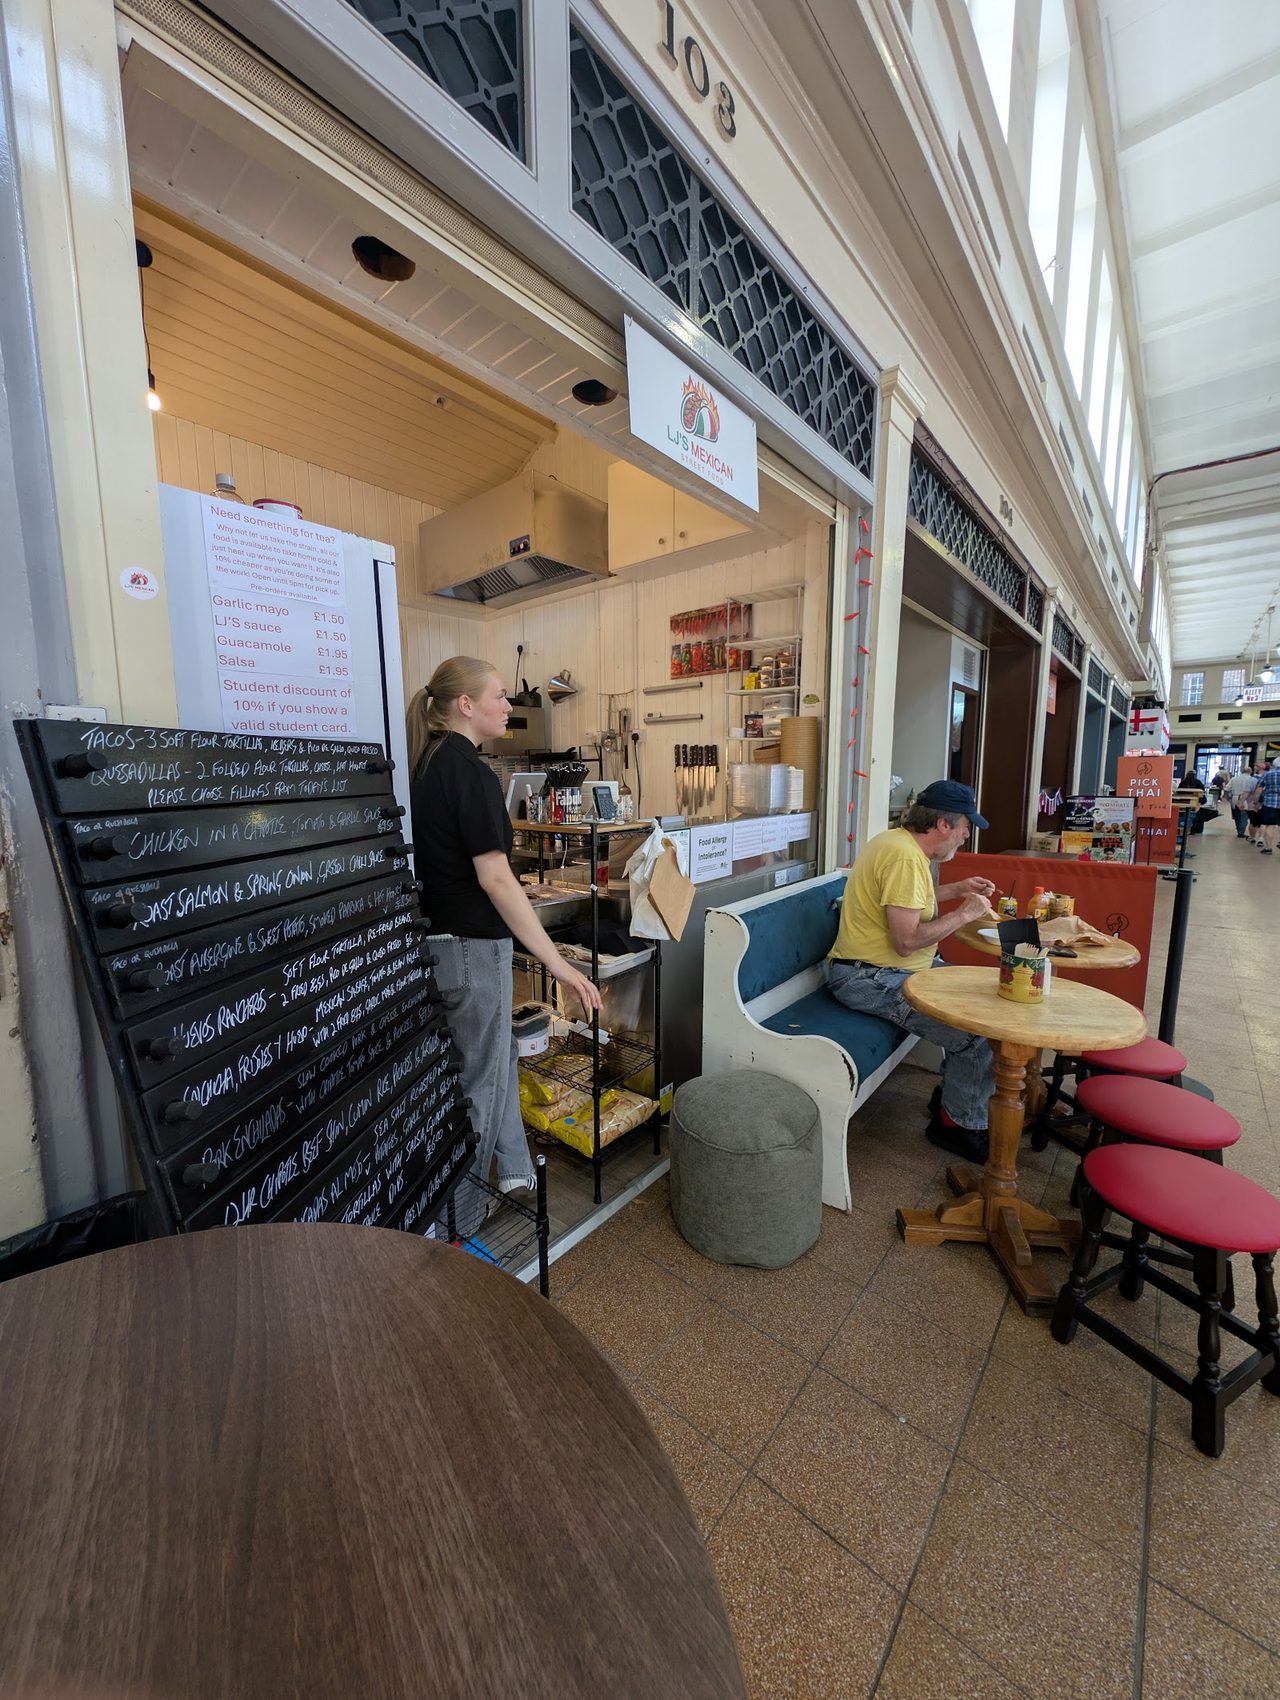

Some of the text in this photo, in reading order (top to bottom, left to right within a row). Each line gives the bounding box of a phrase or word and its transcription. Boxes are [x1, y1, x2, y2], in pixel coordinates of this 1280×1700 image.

[662, 0, 736, 137] 103
[667, 424, 734, 481] LJ'S MEXICAN
[681, 453, 724, 485] STREET FOOD
[211, 506, 336, 545] Need something for tea?
[217, 524, 234, 534] Why
[236, 529, 248, 537] not
[249, 530, 259, 538] let
[270, 535, 285, 545] take
[286, 539, 297, 548] the
[299, 542, 319, 553] strain,
[212, 544, 226, 553] just
[228, 546, 245, 556] heat
[246, 551, 256, 559] up
[257, 553, 277, 565] when
[278, 559, 290, 568] you
[291, 561, 307, 570] want
[327, 569, 340, 577] also
[213, 533, 231, 543] food
[240, 538, 273, 552] available
[282, 548, 297, 558] take
[298, 552, 317, 562] home
[318, 557, 331, 566] cold
[215, 555, 232, 564] 10%
[233, 557, 262, 570] cheaper
[274, 567, 295, 578] you're
[296, 571, 313, 582] doing
[315, 576, 332, 585] some
[333, 578, 340, 586] of
[216, 565, 229, 574] the
[252, 572, 272, 582] Open
[273, 575, 288, 585] until
[315, 585, 328, 594] pick
[250, 583, 287, 596] Pre-orders
[213, 595, 345, 625] Garlic mayo £1.50
[215, 615, 346, 642] LJ'S sauce £1.50
[217, 635, 348, 659] Guacamole £1.95
[219, 655, 349, 676] Salsa £1.95
[223, 679, 351, 698] Student discount of
[234, 700, 347, 715] 10% if you show a
[232, 720, 351, 733] valid student card.
[160, 731, 187, 748] SOFT
[191, 731, 221, 749] FLOUR
[90, 762, 180, 786] QUESADILLAS
[197, 762, 210, 779] 2
[212, 760, 249, 777] FOLDED
[254, 760, 277, 775] FLOUR
[148, 787, 187, 808] PLEASE
[192, 786, 224, 802] CHOOSE
[230, 782, 270, 800] FILLINGS
[274, 782, 296, 795] FROM
[1128, 789, 1160, 797] THAI
[74, 822, 90, 834] TACO
[93, 822, 102, 830] OR
[1140, 828, 1168, 836] THAI
[128, 827, 199, 860] CHICKEN
[208, 825, 225, 845] IN
[232, 823, 239, 841] A
[699, 837, 711, 847] Food
[712, 836, 727, 844] Allergy
[698, 849, 727, 861] Intolerance?
[91, 892, 111, 904] TACO
[176, 881, 228, 918] SALMON
[234, 882, 243, 902] &
[247, 869, 282, 900] SPRING
[111, 953, 141, 971] TACO OR
[190, 936, 244, 976] AUBERGINE
[283, 958, 305, 986] SOFT
[309, 950, 330, 970] FLOUR
[281, 993, 289, 1007] 2
[291, 981, 308, 1000] FRIED
[316, 990, 345, 1023] MEXICAN
[298, 1065, 316, 1089] SLOW
[374, 1118, 388, 1146] SEA
[302, 1128, 323, 1174] BEEF
